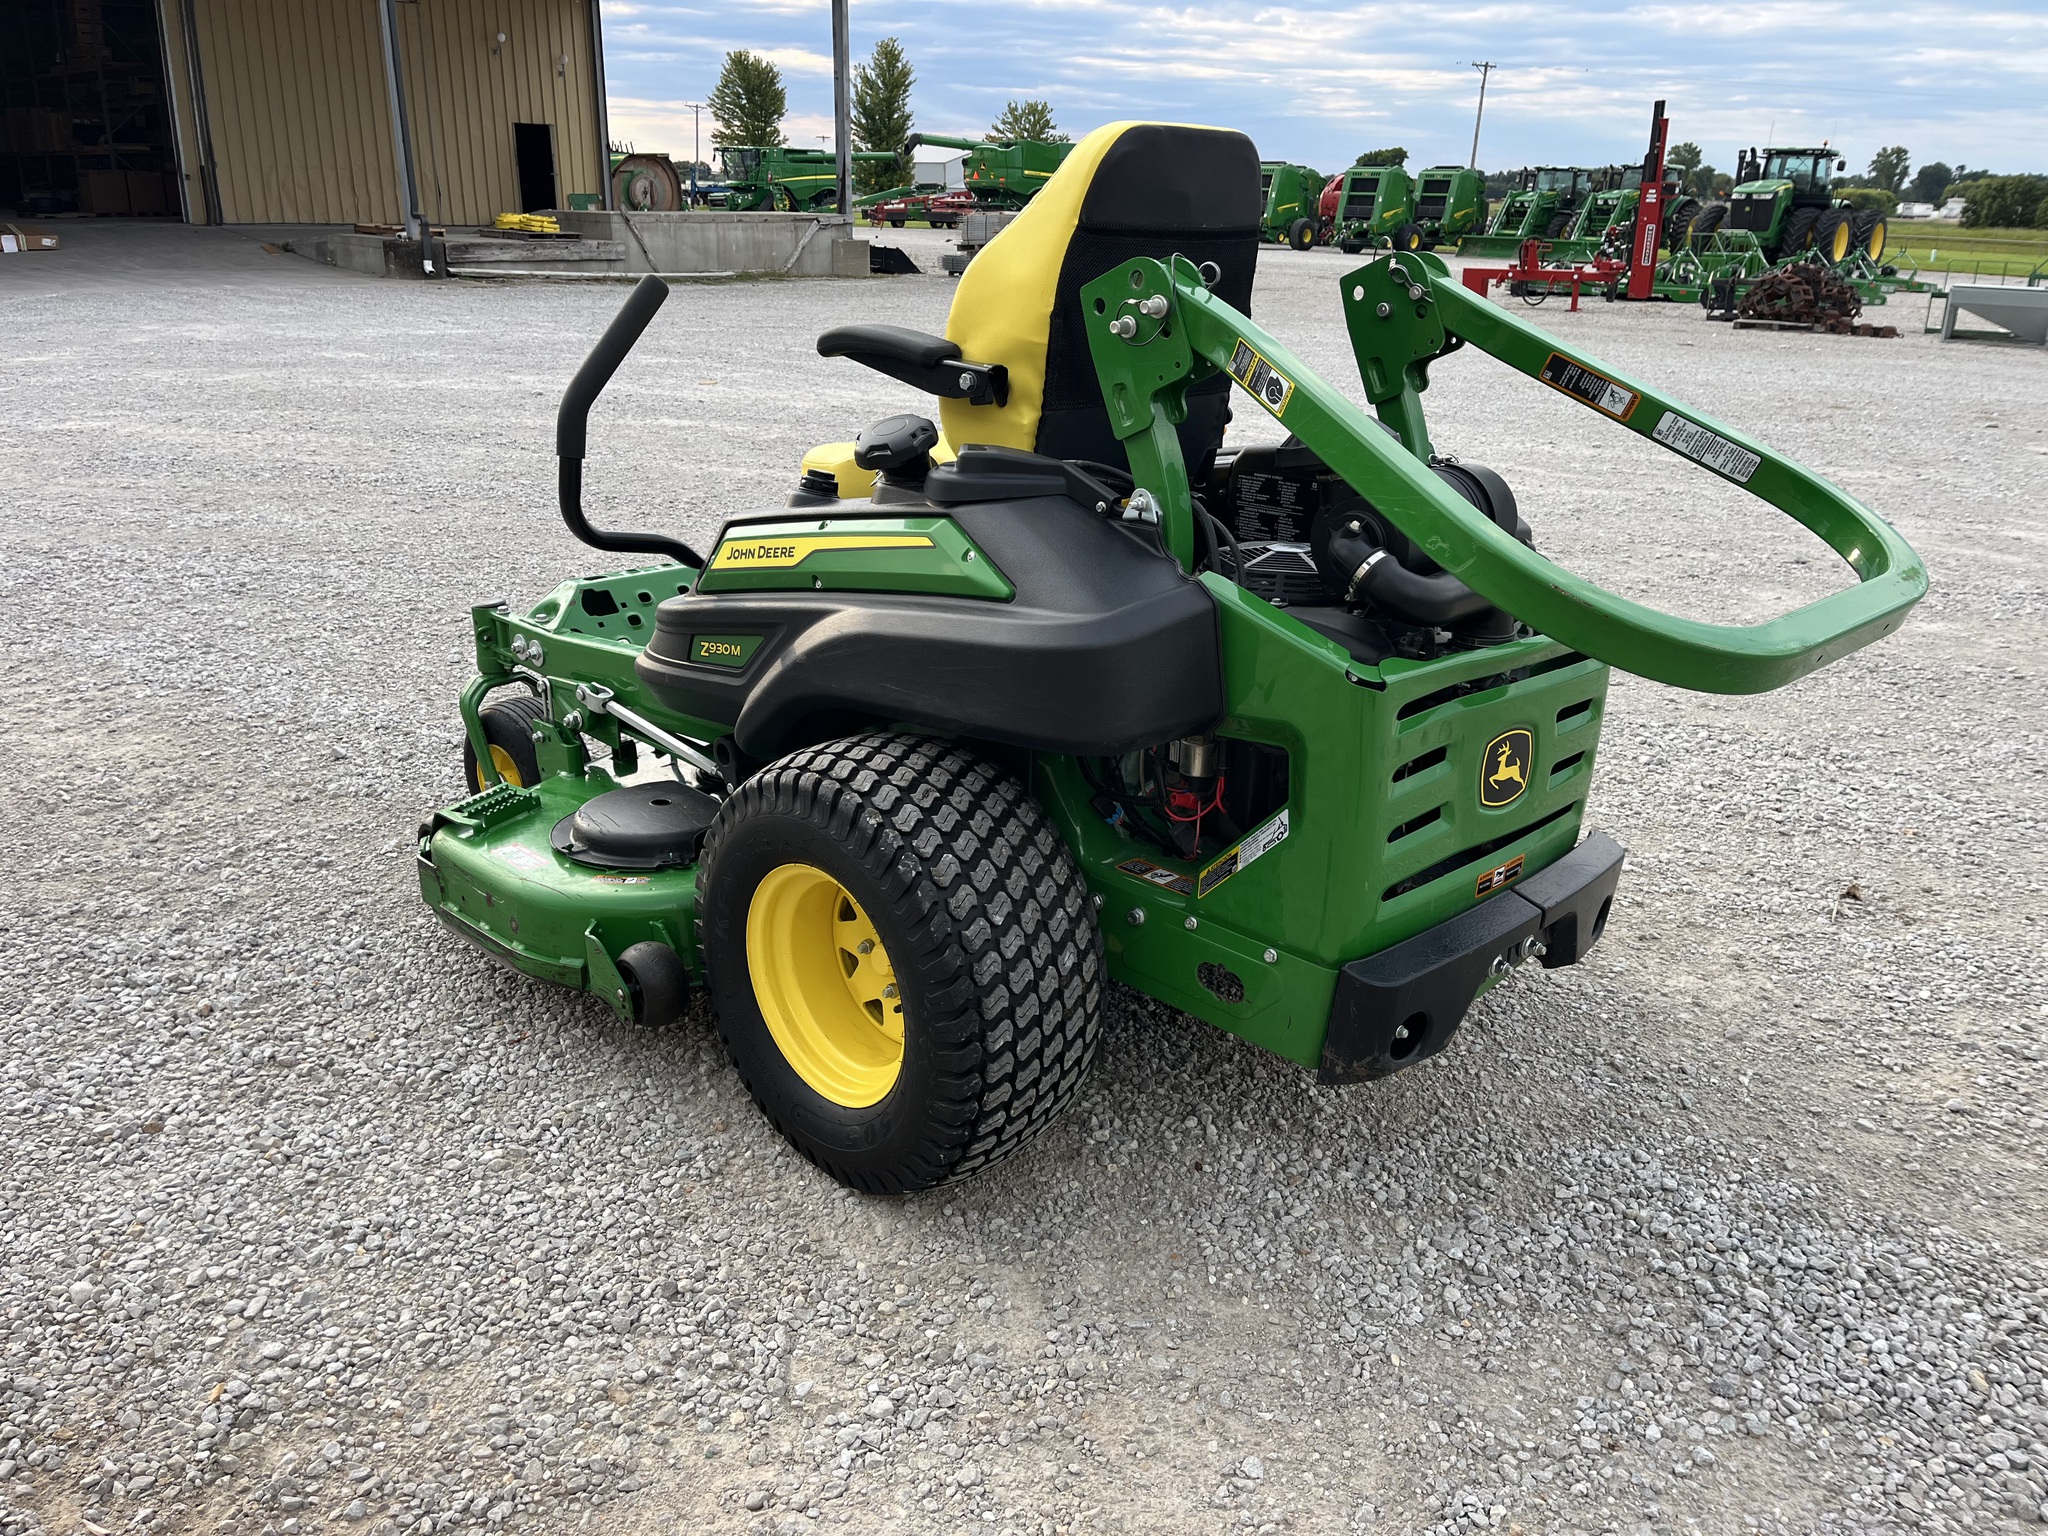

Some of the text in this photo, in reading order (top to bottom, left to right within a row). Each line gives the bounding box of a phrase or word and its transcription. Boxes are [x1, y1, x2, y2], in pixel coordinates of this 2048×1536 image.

[726, 546, 796, 560] JOHN DEERE
[700, 642, 741, 656] Z930M
